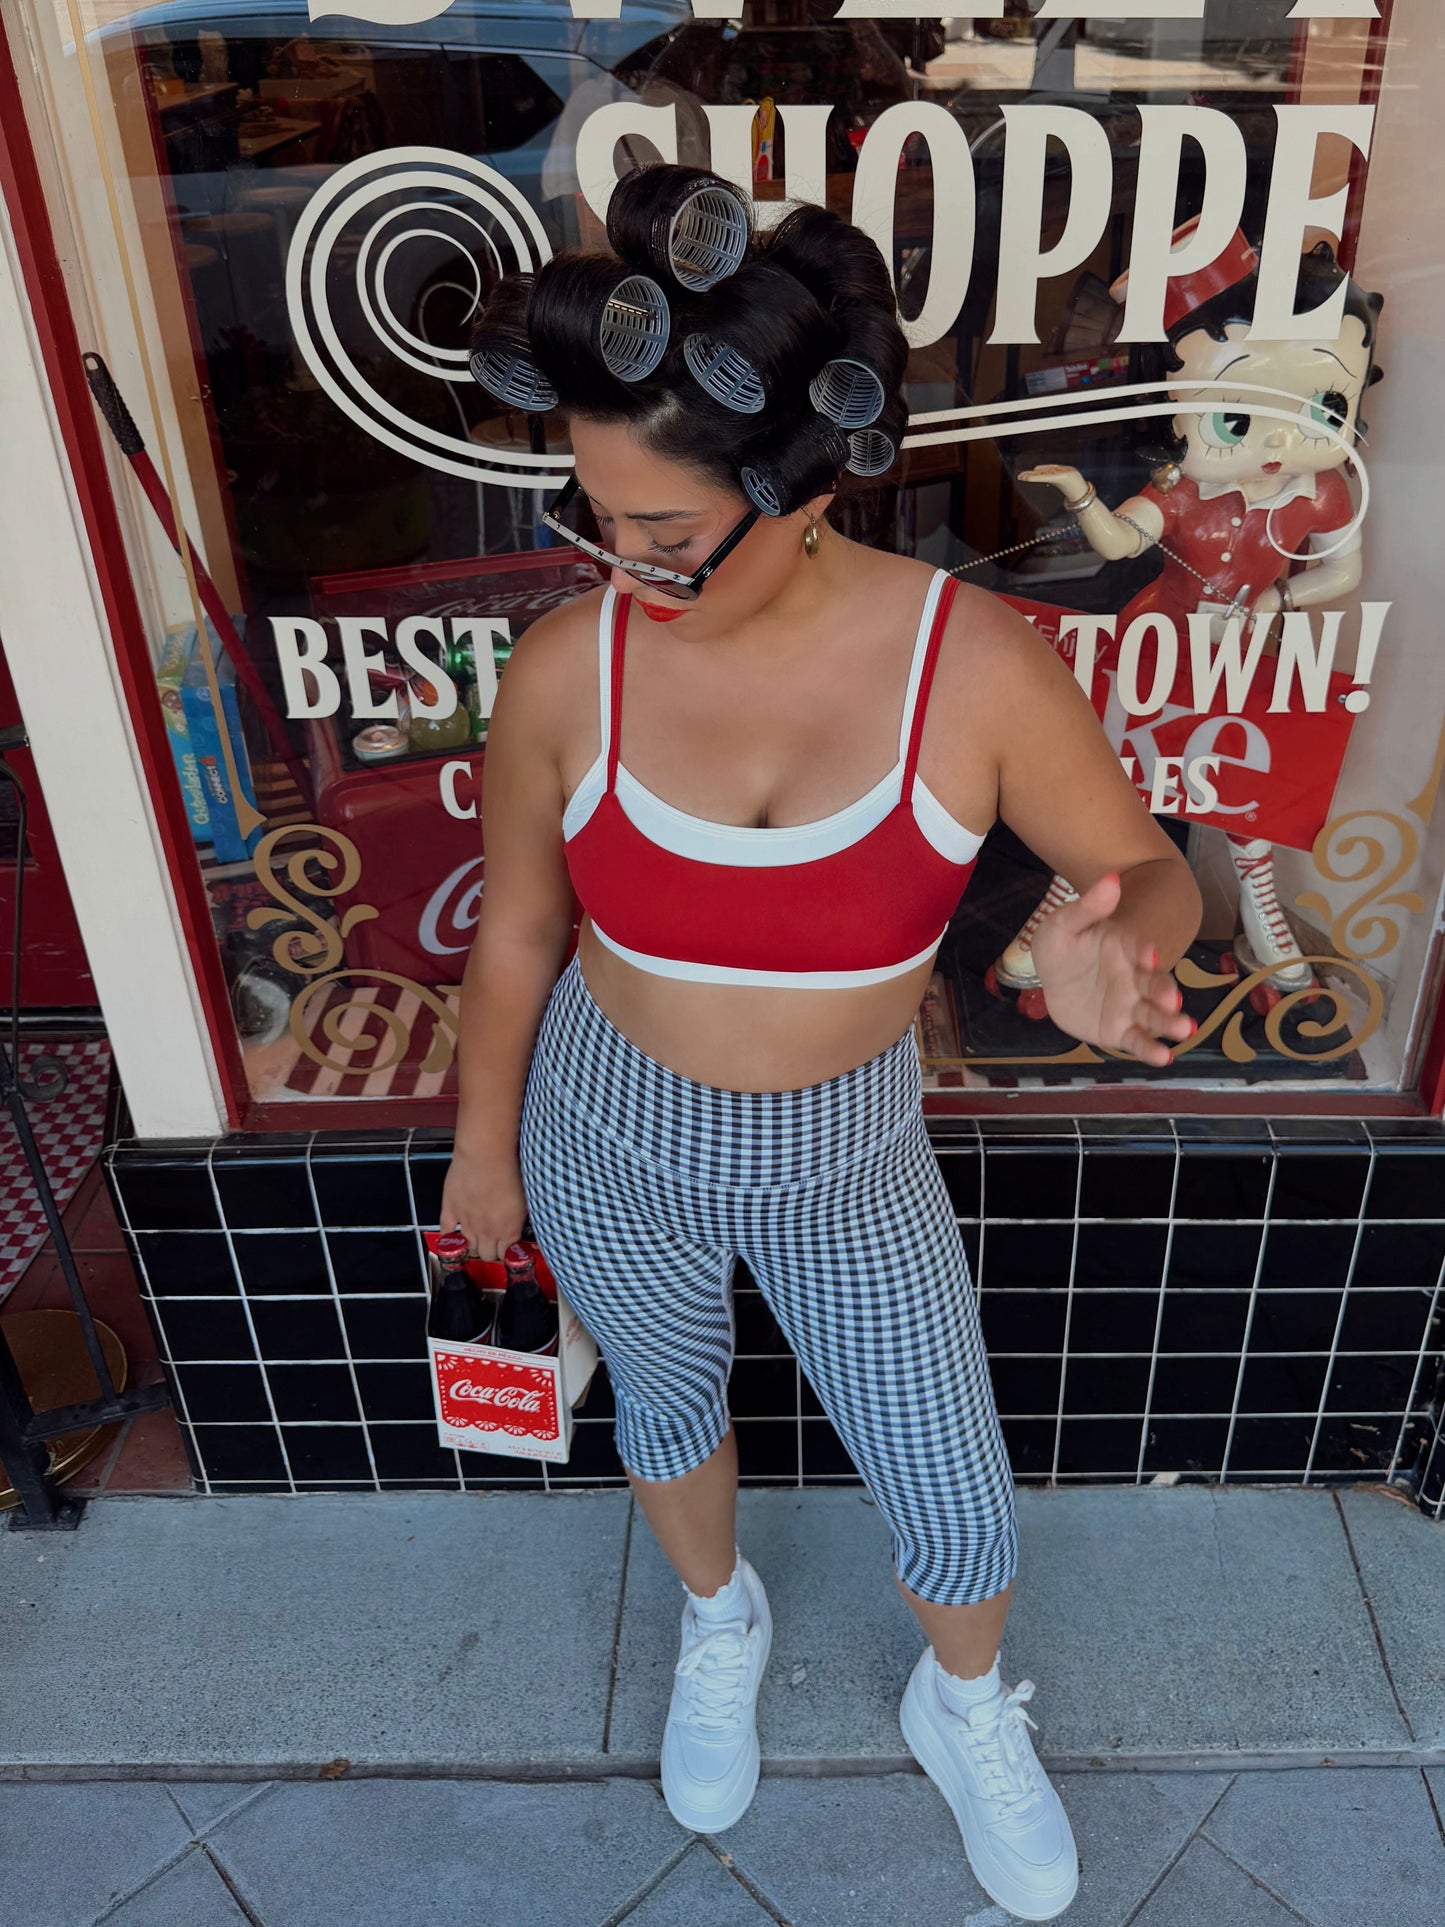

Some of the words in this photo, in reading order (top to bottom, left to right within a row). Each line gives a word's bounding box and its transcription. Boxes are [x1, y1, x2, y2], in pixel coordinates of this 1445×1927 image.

[266, 615, 513, 721] BEST
[1058, 602, 1393, 716] TOWN!
[449, 1379, 545, 1413] Coca-Cola
